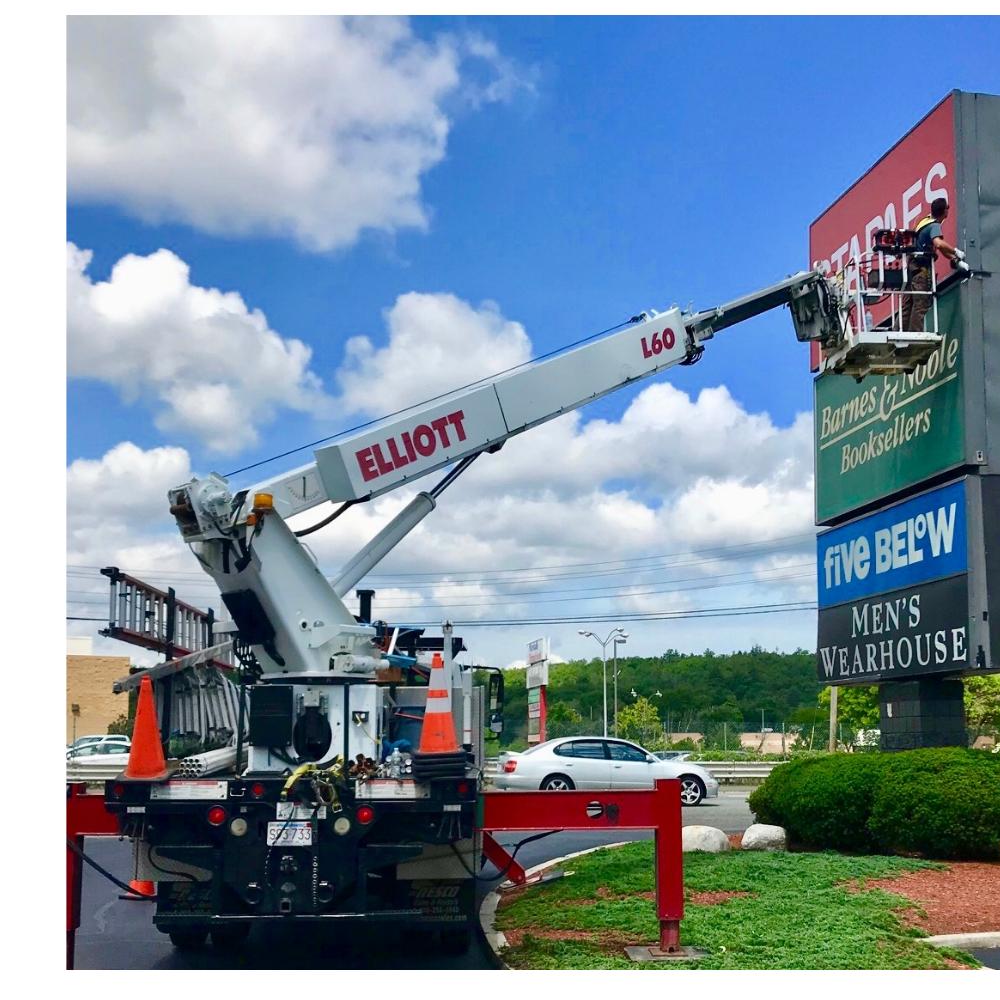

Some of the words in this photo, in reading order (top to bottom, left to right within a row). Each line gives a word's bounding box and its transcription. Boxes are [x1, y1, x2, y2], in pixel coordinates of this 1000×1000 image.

[641, 327, 676, 359] L60
[820, 384, 877, 441] Barnes
[879, 374, 899, 422] &
[840, 407, 932, 475] Booksellers
[354, 409, 467, 482] ELLIOTT
[824, 535, 871, 590] five
[875, 502, 957, 575] BELOW
[851, 594, 921, 638] MEN'S
[819, 626, 967, 678] WEARHOUSE
